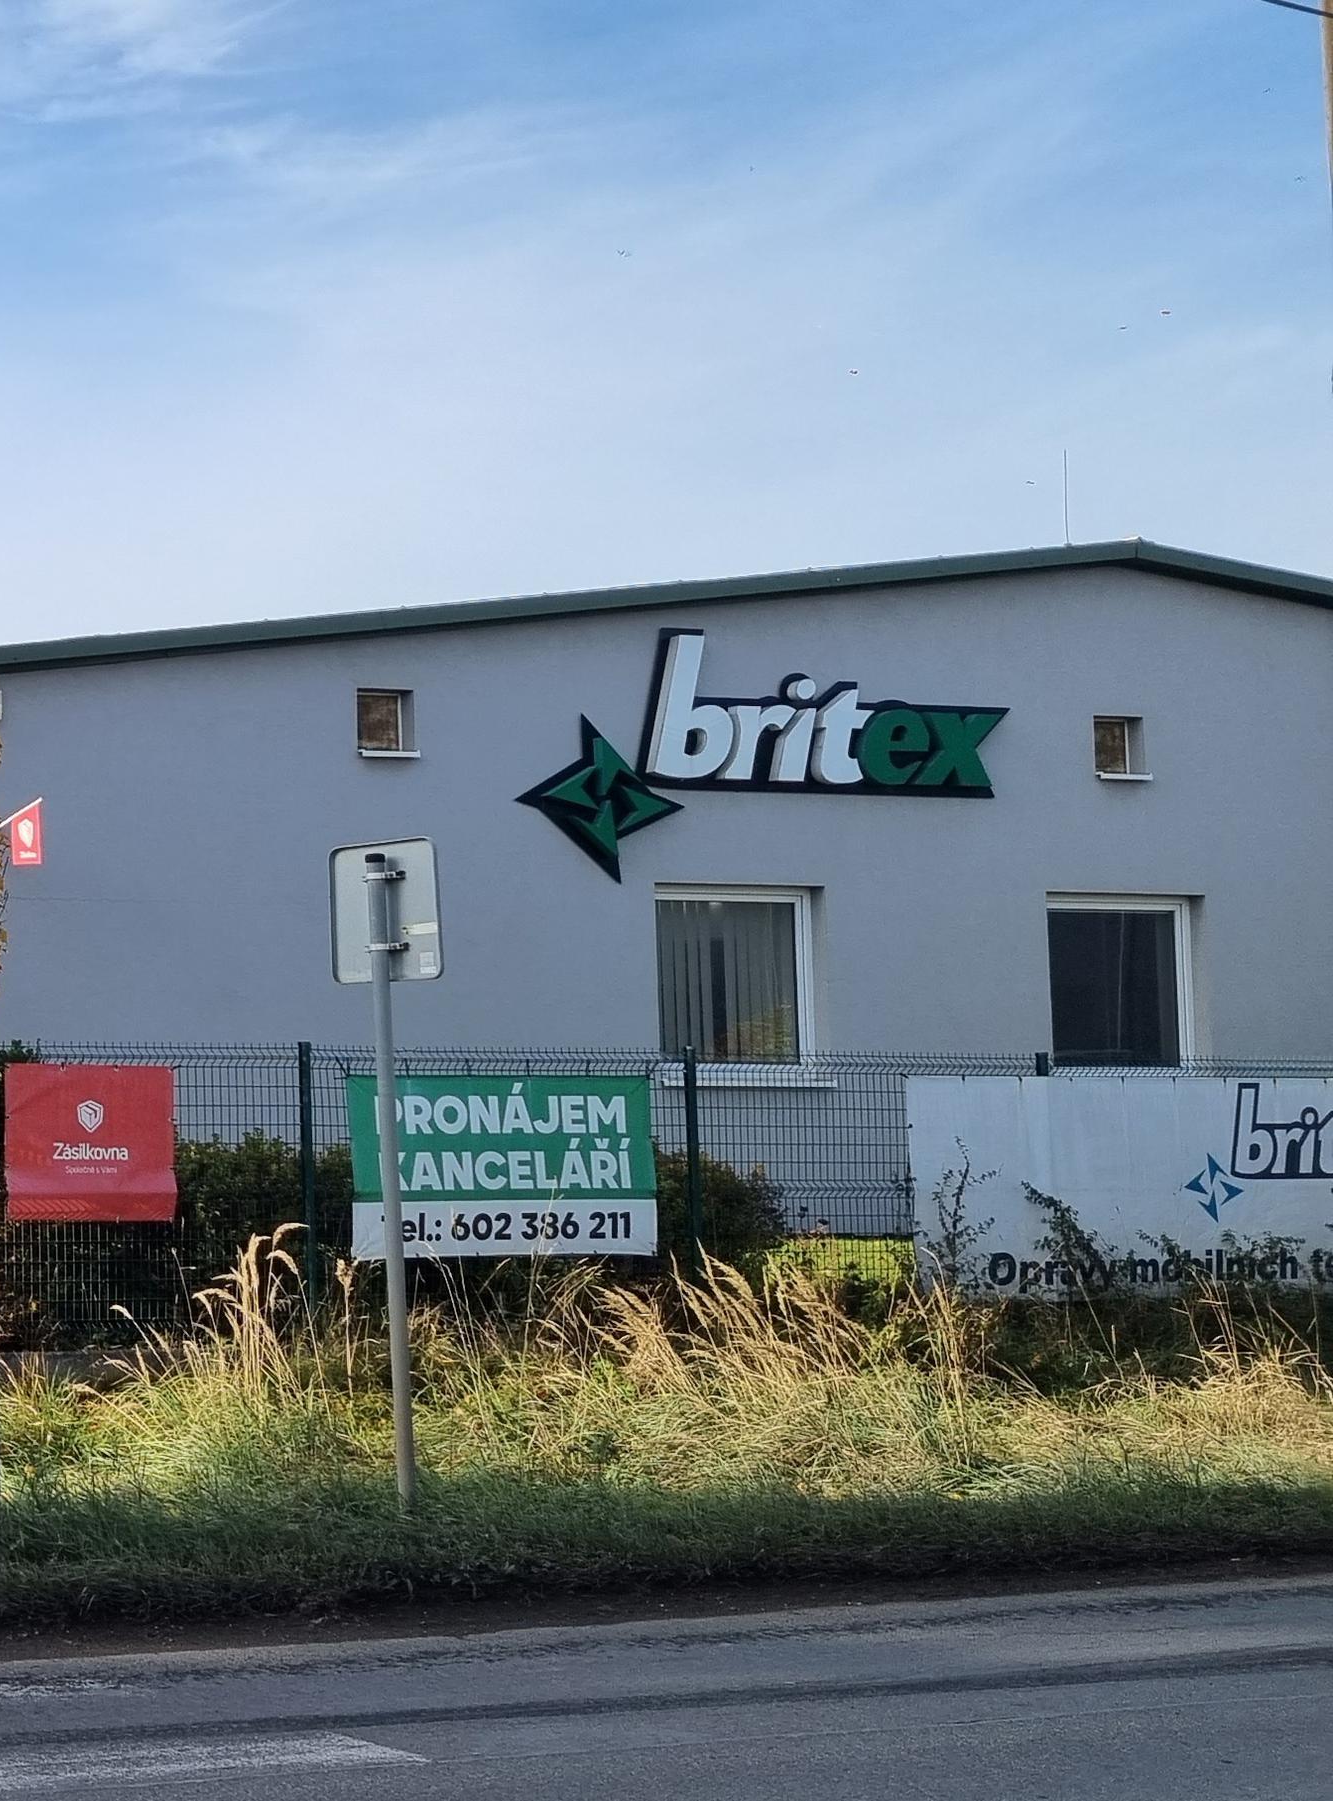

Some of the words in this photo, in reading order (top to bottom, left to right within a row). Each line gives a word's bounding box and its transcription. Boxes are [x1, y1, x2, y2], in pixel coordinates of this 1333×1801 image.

[644, 632, 1003, 789] britex
[52, 1142, 129, 1161] Zásilkovna
[381, 1212, 441, 1242] el.:
[451, 1212, 512, 1242] 602
[521, 1211, 580, 1241] 386
[589, 1211, 631, 1240] 211
